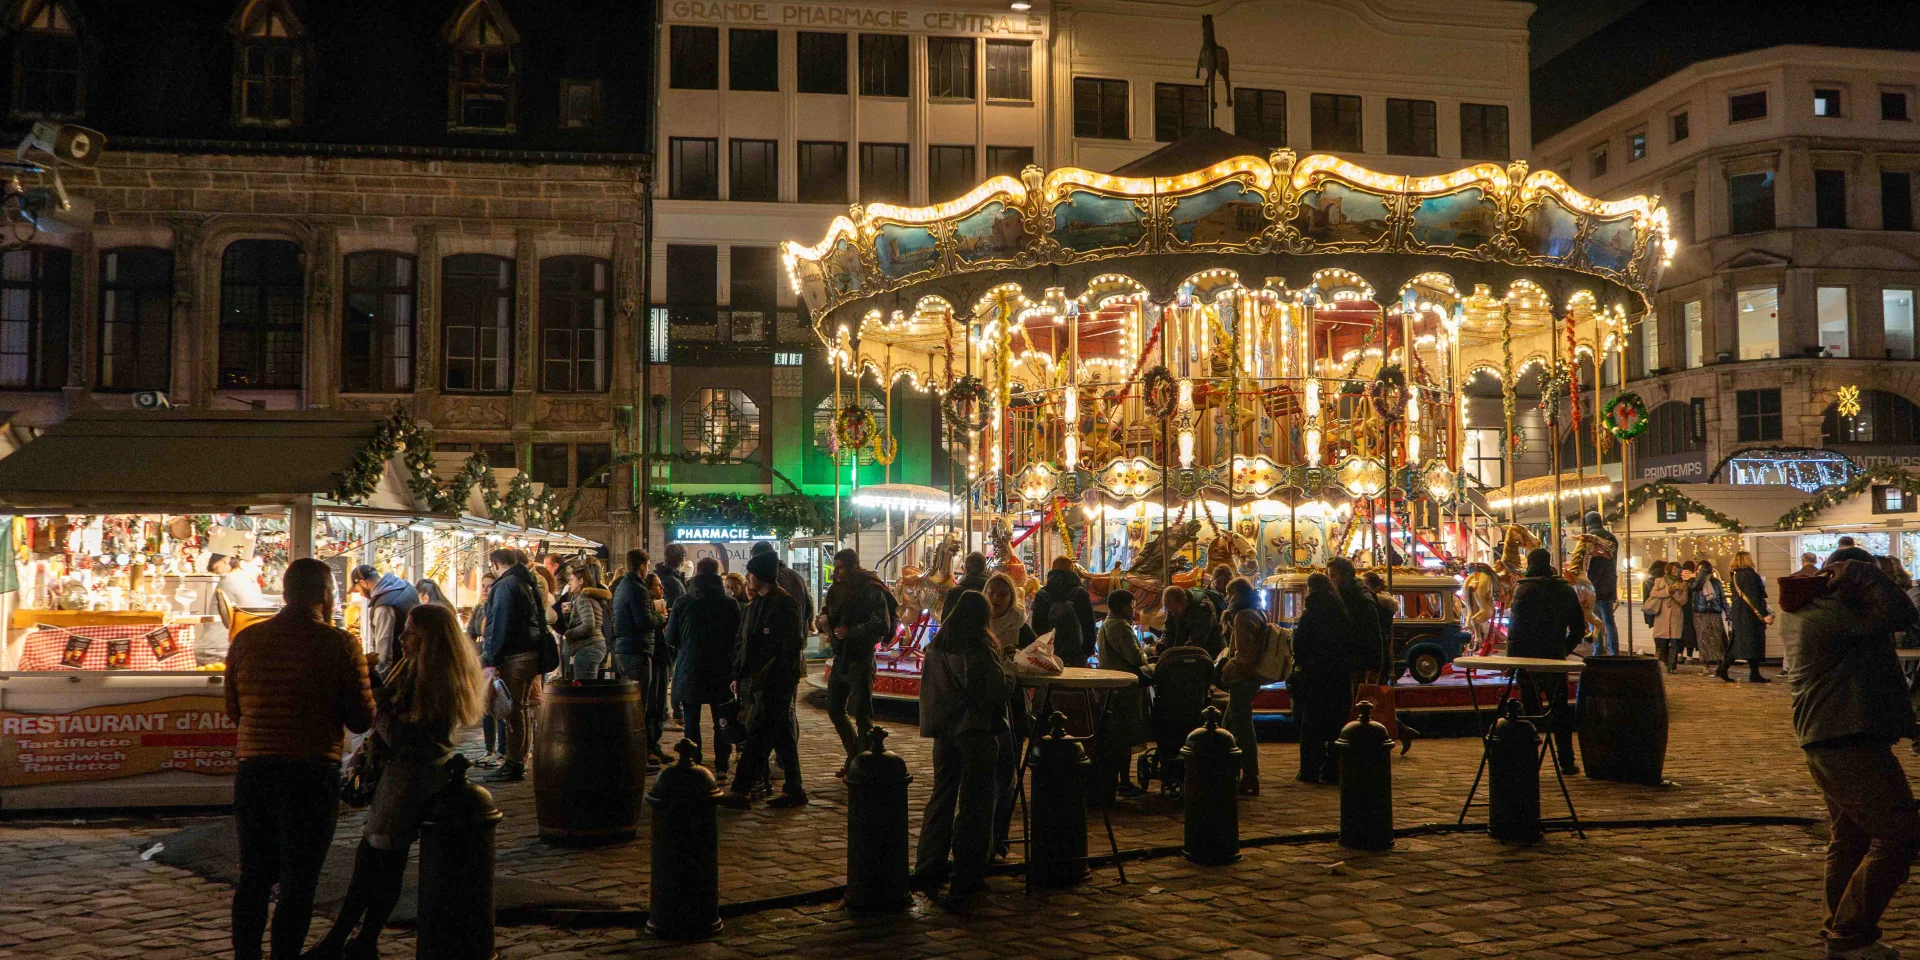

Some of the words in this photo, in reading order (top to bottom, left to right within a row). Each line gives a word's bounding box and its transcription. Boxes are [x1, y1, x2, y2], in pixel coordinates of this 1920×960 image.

[673, 1, 768, 23] GRANDE
[781, 5, 909, 29] PHARMACIE
[922, 12, 1043, 36] CENTRALE
[1644, 462, 1702, 479] PRINTEMPS
[1848, 456, 1920, 473] INTEMPS
[677, 528, 750, 539] PHARMACIE
[2, 713, 168, 735] RESTAURANT
[176, 712, 237, 731] d'Alt
[17, 737, 132, 749] Tartiflette
[18, 751, 126, 764] Sandwich
[160, 759, 187, 769] de
[24, 761, 121, 773] Raclette
